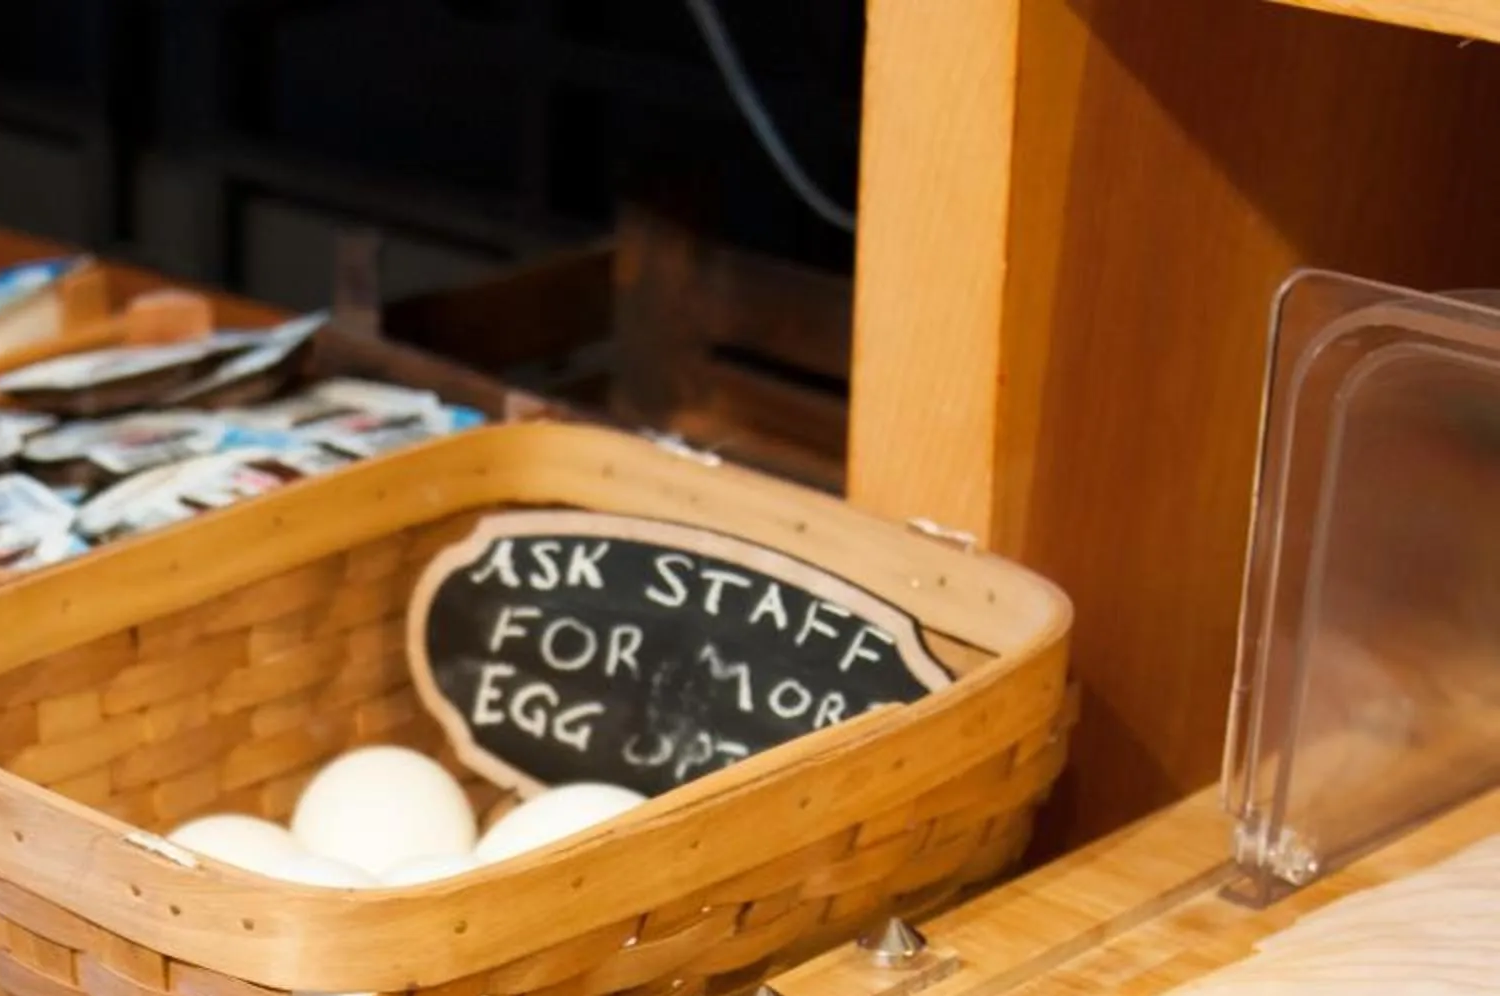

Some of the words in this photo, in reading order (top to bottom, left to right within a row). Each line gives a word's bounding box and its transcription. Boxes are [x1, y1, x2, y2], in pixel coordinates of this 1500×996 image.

[470, 536, 609, 591] ASK
[645, 553, 894, 672] STAFF
[472, 664, 605, 751] EGG
[489, 607, 644, 677] FOR
[699, 643, 893, 729] MOR
